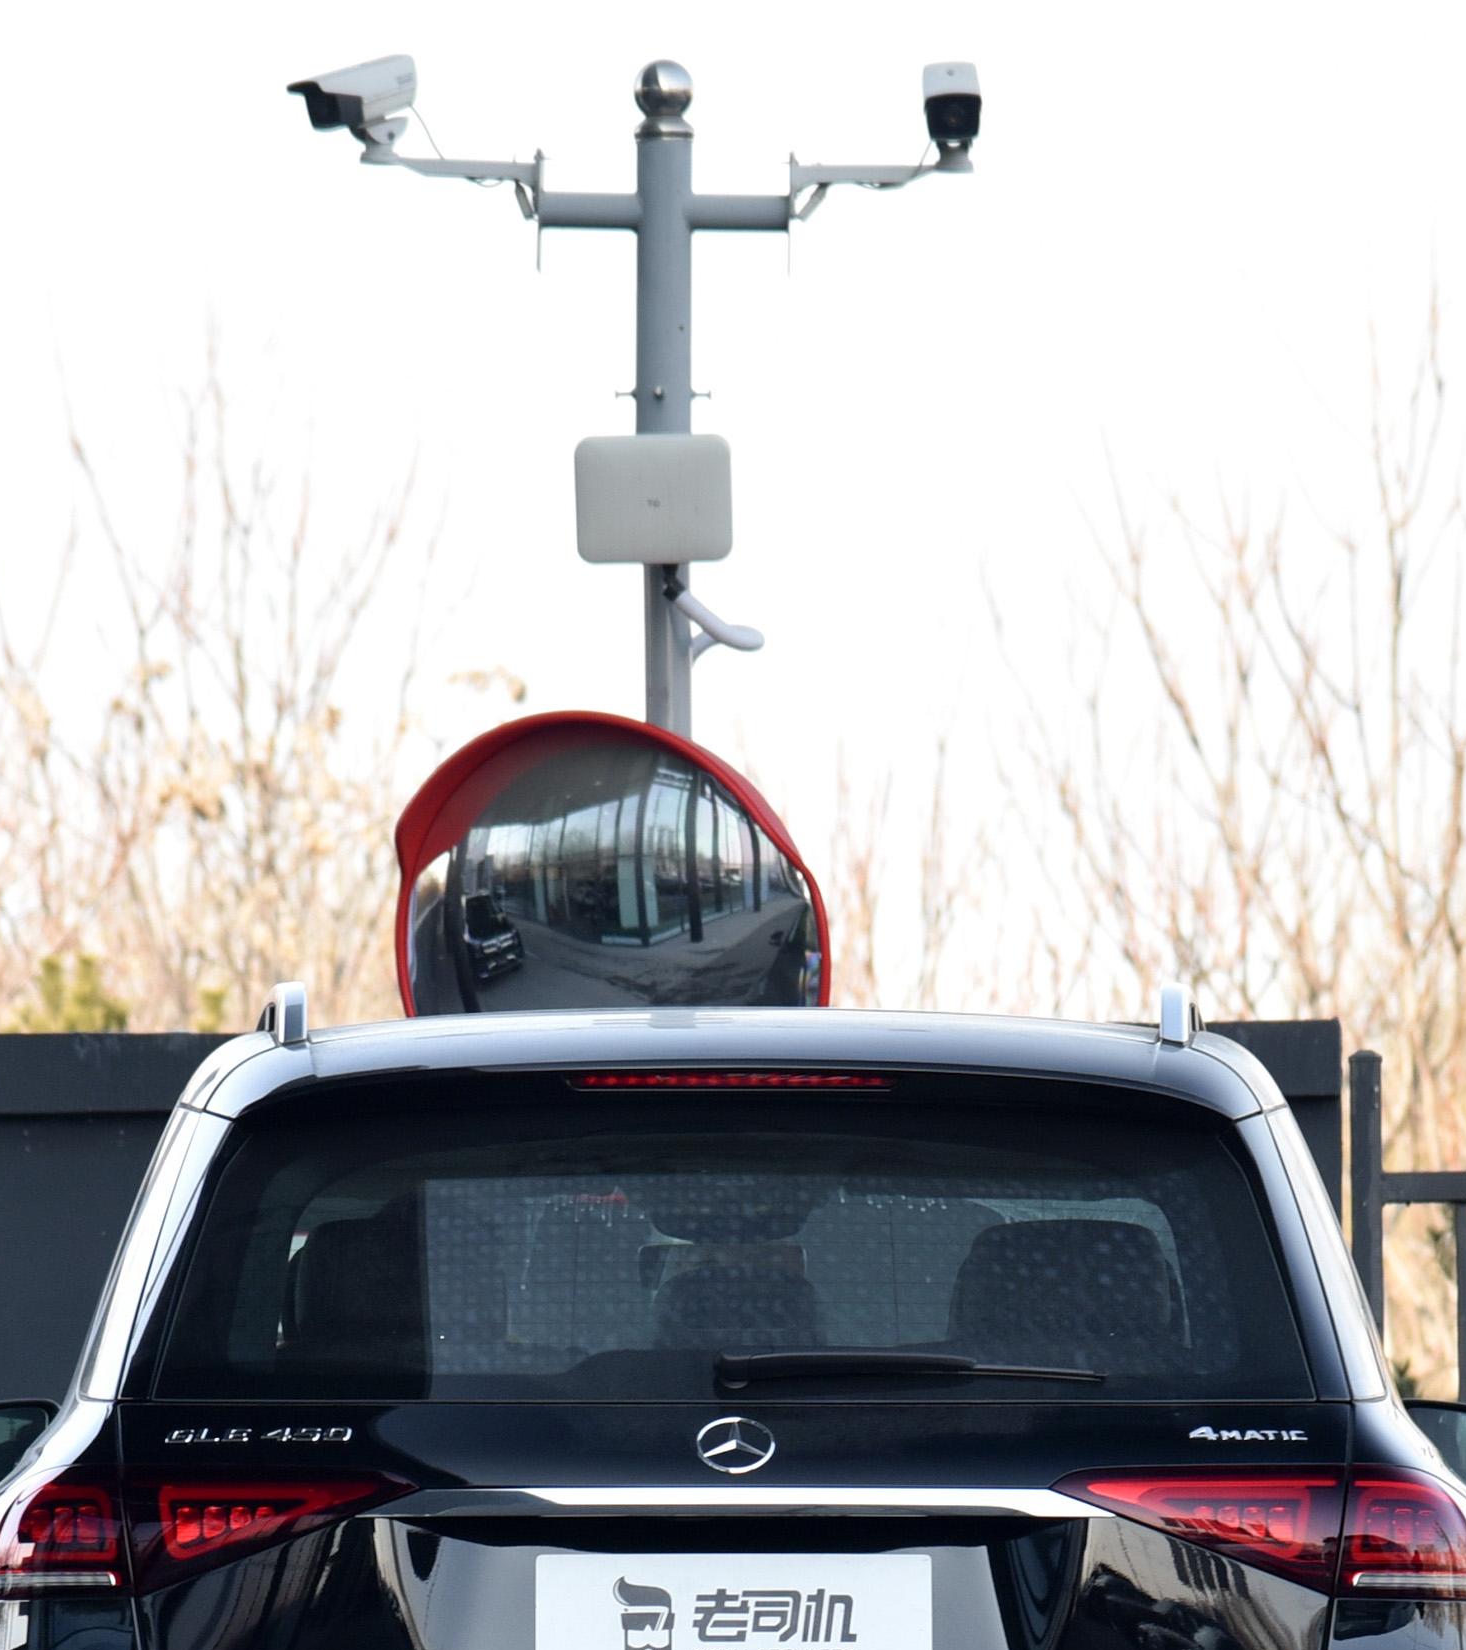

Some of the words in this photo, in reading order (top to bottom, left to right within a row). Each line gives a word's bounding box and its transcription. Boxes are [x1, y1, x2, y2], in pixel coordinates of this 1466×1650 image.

[164, 1427, 252, 1443] GLE
[260, 1427, 352, 1442] 450
[1189, 1425, 1308, 1441] 4MATIC
[692, 1588, 857, 1643] 老司机
